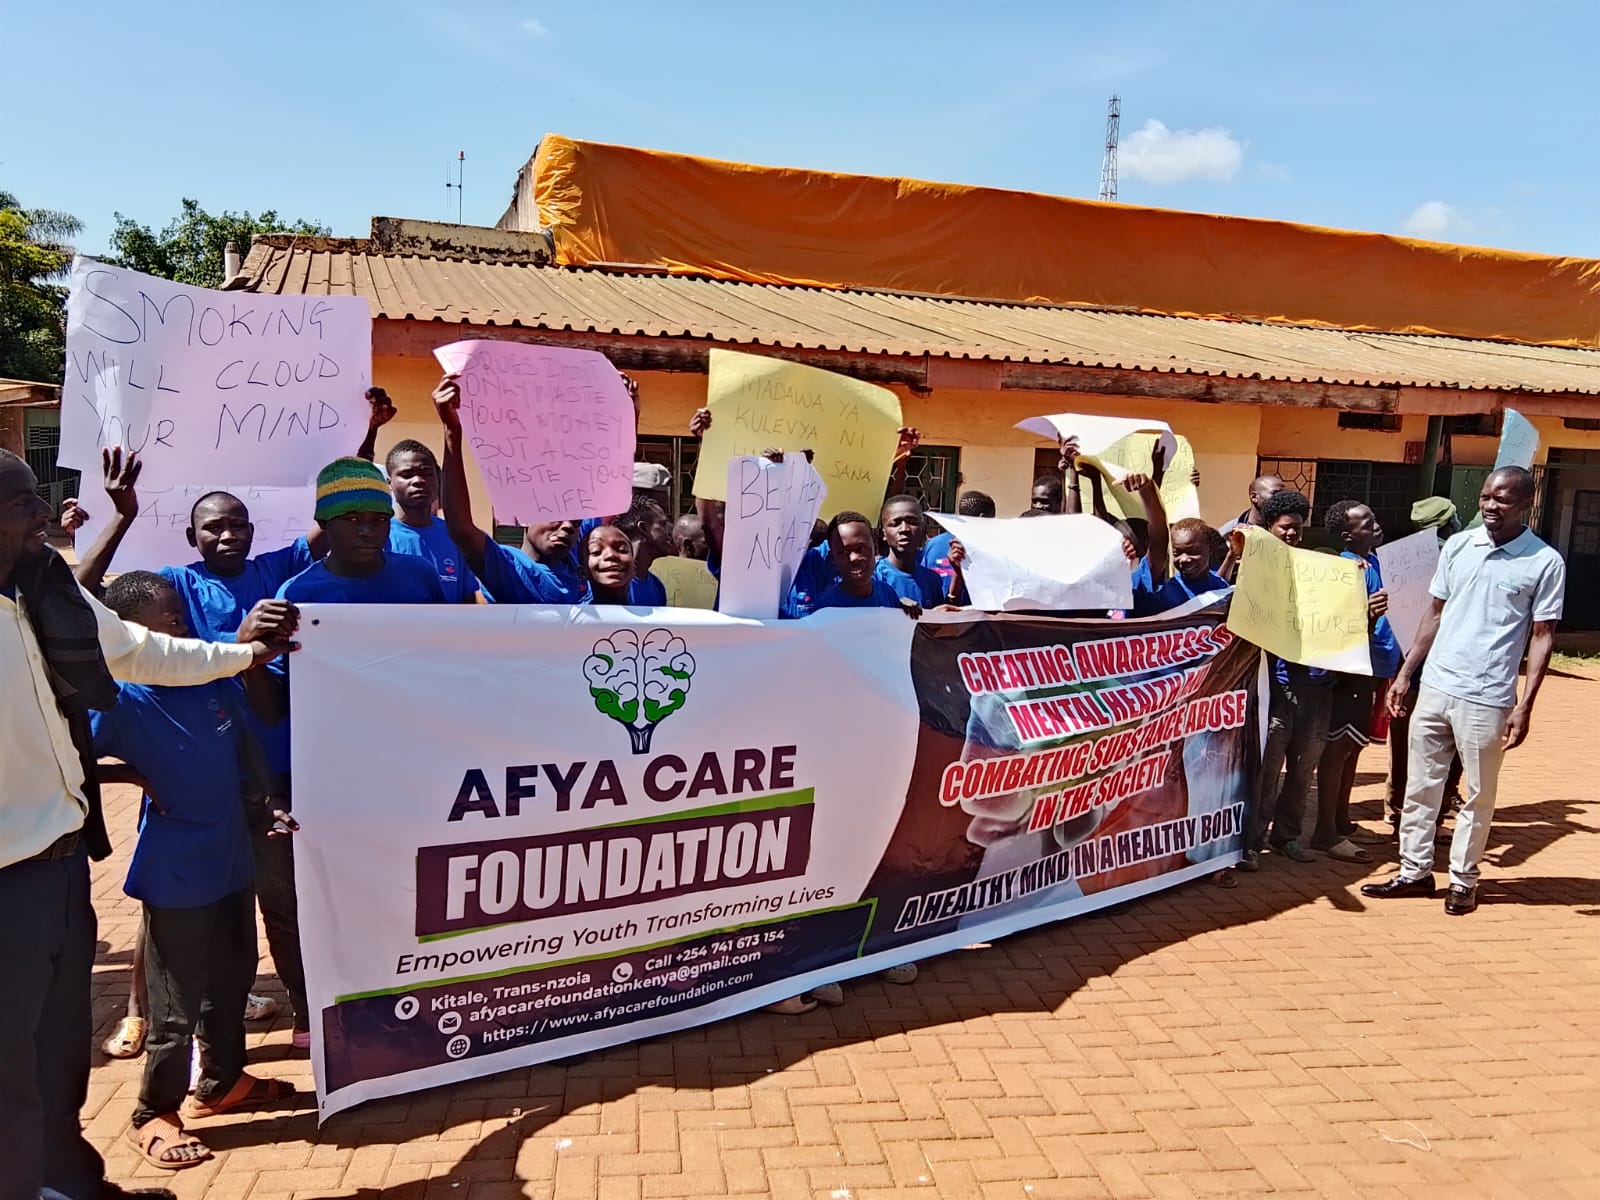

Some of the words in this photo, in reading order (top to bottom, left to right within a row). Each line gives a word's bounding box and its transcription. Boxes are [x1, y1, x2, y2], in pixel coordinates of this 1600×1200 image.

[82, 270, 333, 346] SMOKING
[73, 350, 180, 393] WILL
[216, 353, 339, 390] CLOUD
[465, 372, 530, 409] ONLY
[741, 374, 824, 412] MADAWA
[837, 397, 859, 422] YA
[82, 394, 175, 454] YOUR
[216, 400, 347, 450] MIND.
[462, 400, 527, 433] YOUR
[536, 411, 623, 449] MONEY
[470, 436, 529, 461] BUT
[540, 438, 611, 462] ALSO
[734, 405, 818, 441] KULEVYA
[840, 429, 865, 448] NI
[483, 464, 561, 487] WASTE
[581, 465, 631, 494] YOUR
[741, 460, 781, 519] BE
[827, 460, 871, 482] SANA
[532, 488, 597, 513] LIFE
[1284, 552, 1356, 586] ABUSE
[1287, 609, 1369, 636] FUTURE
[959, 645, 1075, 694] CREATING
[1073, 626, 1217, 684] AWARENESS
[1006, 695, 1111, 742] MENTAL
[1100, 673, 1183, 724] HEALTH
[940, 742, 1093, 805] COMBATING
[1089, 709, 1187, 770] SUBSTANCE
[1181, 691, 1246, 736] ABUSE
[447, 760, 628, 822] AFYA
[643, 745, 797, 800] CARE
[1028, 796, 1059, 833] IN
[1058, 782, 1096, 824] THE
[1095, 752, 1170, 806] SOCIETY
[446, 817, 792, 921] FOUNDATION
[895, 897, 921, 932] A
[919, 869, 1016, 923] HEALTHY
[1019, 852, 1070, 896] MIND
[1072, 844, 1097, 876] IN
[1098, 836, 1116, 870] A
[1118, 817, 1197, 864] HEALTHY
[1201, 802, 1244, 843] BODY
[395, 930, 564, 975] Empowering
[573, 920, 639, 950] Youth
[646, 898, 783, 935] Transforming
[787, 884, 836, 907] Lives
[645, 954, 672, 971] Call
[675, 946, 708, 963] +254
[711, 939, 732, 955] 741
[736, 934, 760, 949] 673
[763, 929, 785, 942] 154
[431, 991, 489, 1012] Kitale,
[493, 971, 591, 1000] Trans-nzoia
[469, 951, 761, 1022] afyacarefoundationkenya@gmail.com
[483, 972, 753, 1044] https://www.afyacarefoundation.com
